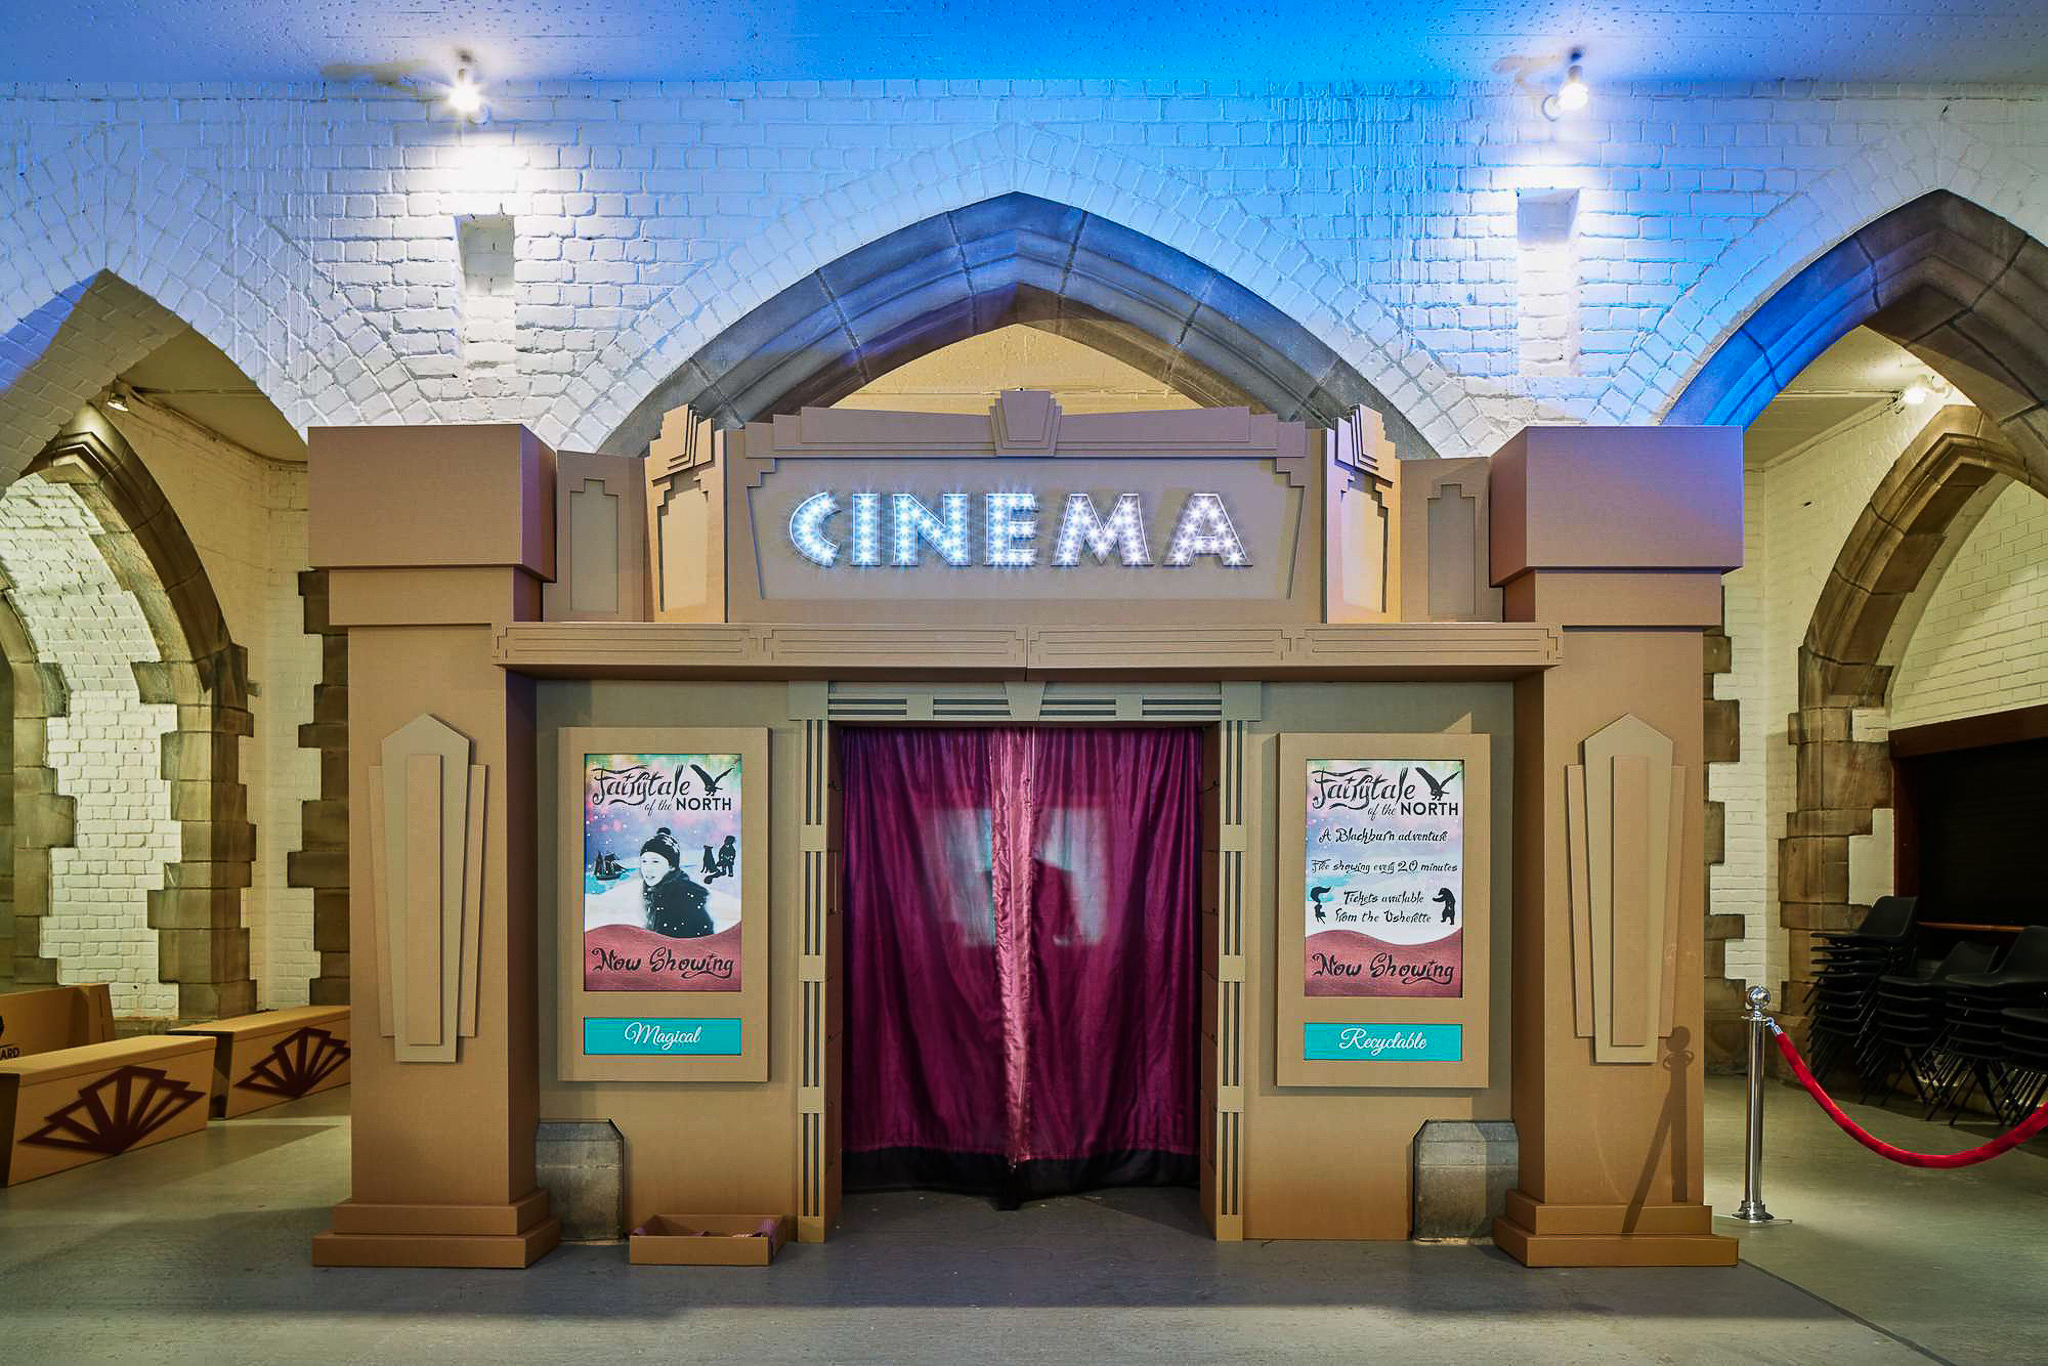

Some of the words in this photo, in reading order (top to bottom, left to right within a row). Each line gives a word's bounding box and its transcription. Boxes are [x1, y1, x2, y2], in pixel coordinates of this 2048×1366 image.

[789, 491, 1253, 567] CINEMA
[591, 764, 691, 806] Fairytale
[1311, 767, 1416, 811] Fairytale
[644, 798, 655, 816] of
[658, 799, 672, 811] the
[676, 797, 732, 811] NORTH
[1367, 803, 1378, 820] of
[1381, 803, 1396, 816] the
[1401, 802, 1459, 816] NORTH
[1319, 827, 1332, 843] A
[1335, 827, 1395, 844] Blackburn
[1398, 829, 1449, 843] adventure
[1333, 859, 1371, 874] showing
[1373, 860, 1396, 874] every
[1397, 859, 1418, 872] 20
[1420, 860, 1458, 872] minutes
[1343, 890, 1379, 906] Tickets
[1381, 890, 1425, 905] available
[1361, 910, 1379, 923] the
[1383, 909, 1432, 923] Usherette
[591, 947, 642, 972] Now
[649, 946, 734, 979] Showing
[1311, 952, 1363, 978] Now
[1369, 952, 1455, 985] Showing
[623, 1021, 702, 1051] Magical
[1338, 1027, 1428, 1057] Recyclable
